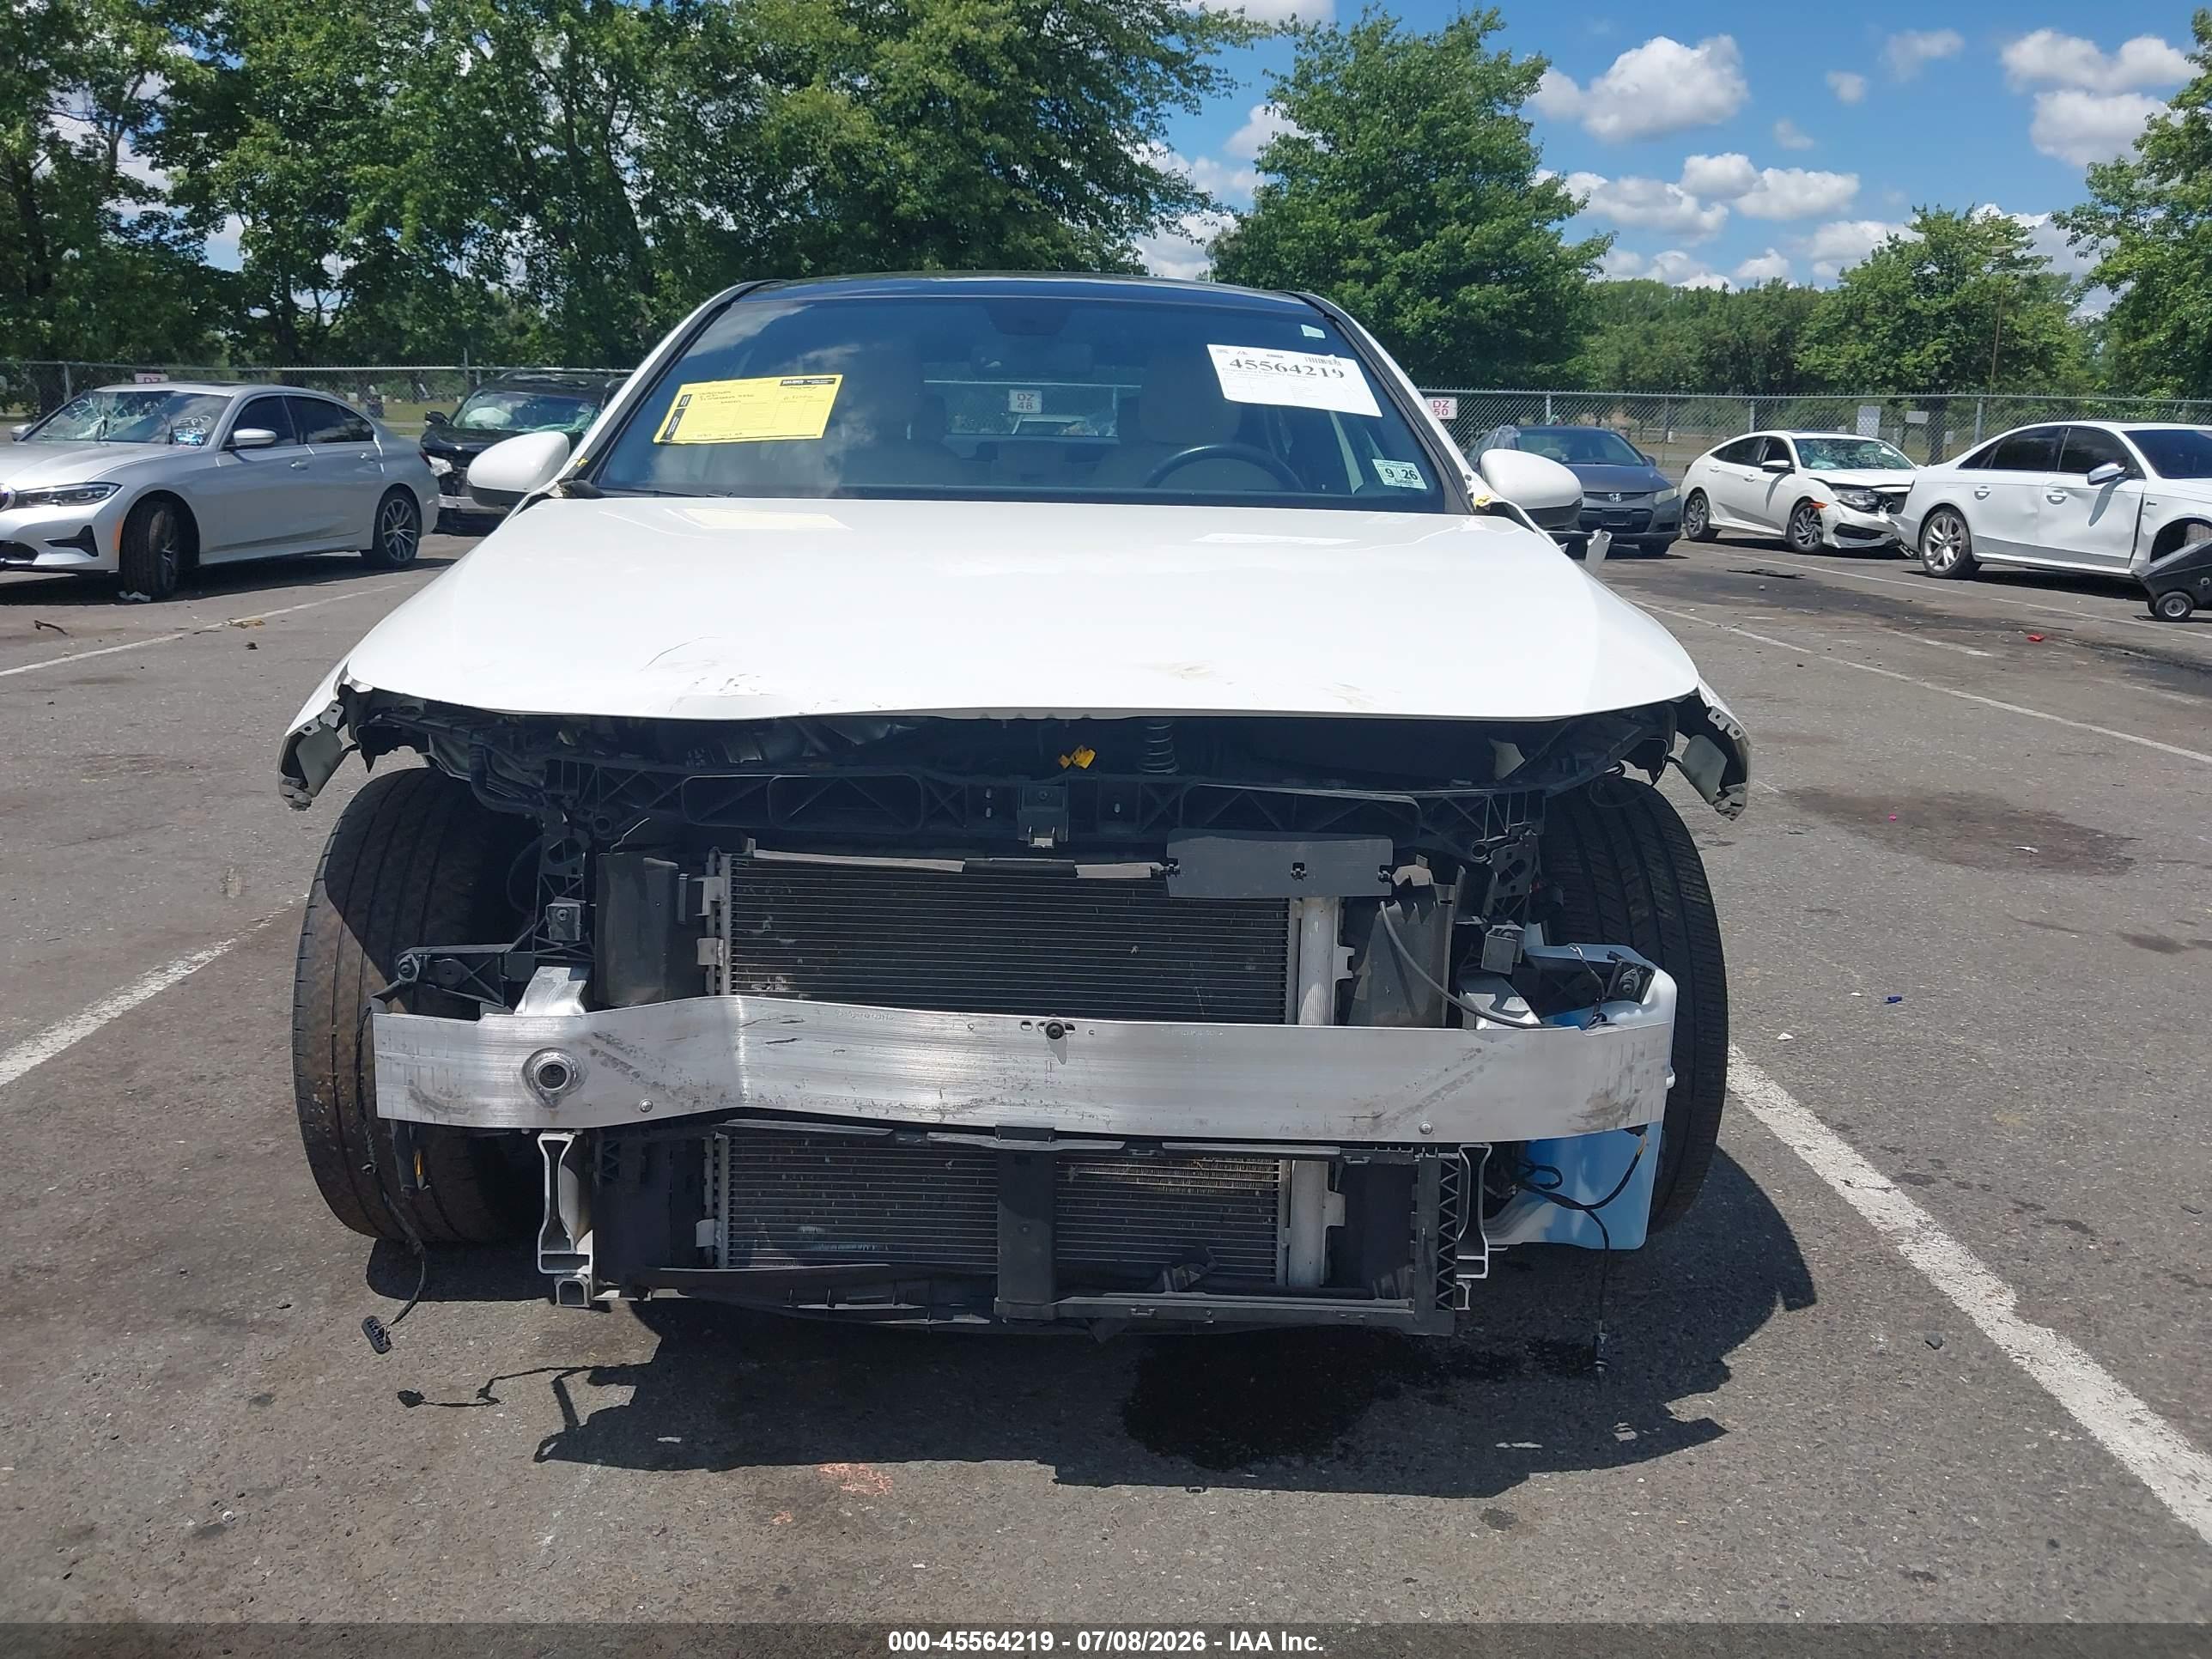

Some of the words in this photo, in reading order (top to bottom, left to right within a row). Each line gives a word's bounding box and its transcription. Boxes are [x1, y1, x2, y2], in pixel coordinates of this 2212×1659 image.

[1229, 357, 1345, 379] 45564219
[1018, 402, 1033, 410] 48
[1432, 399, 1449, 408] DZ
[1433, 408, 1449, 416] 50
[1384, 468, 1395, 478] 9
[1401, 469, 1419, 481] 26
